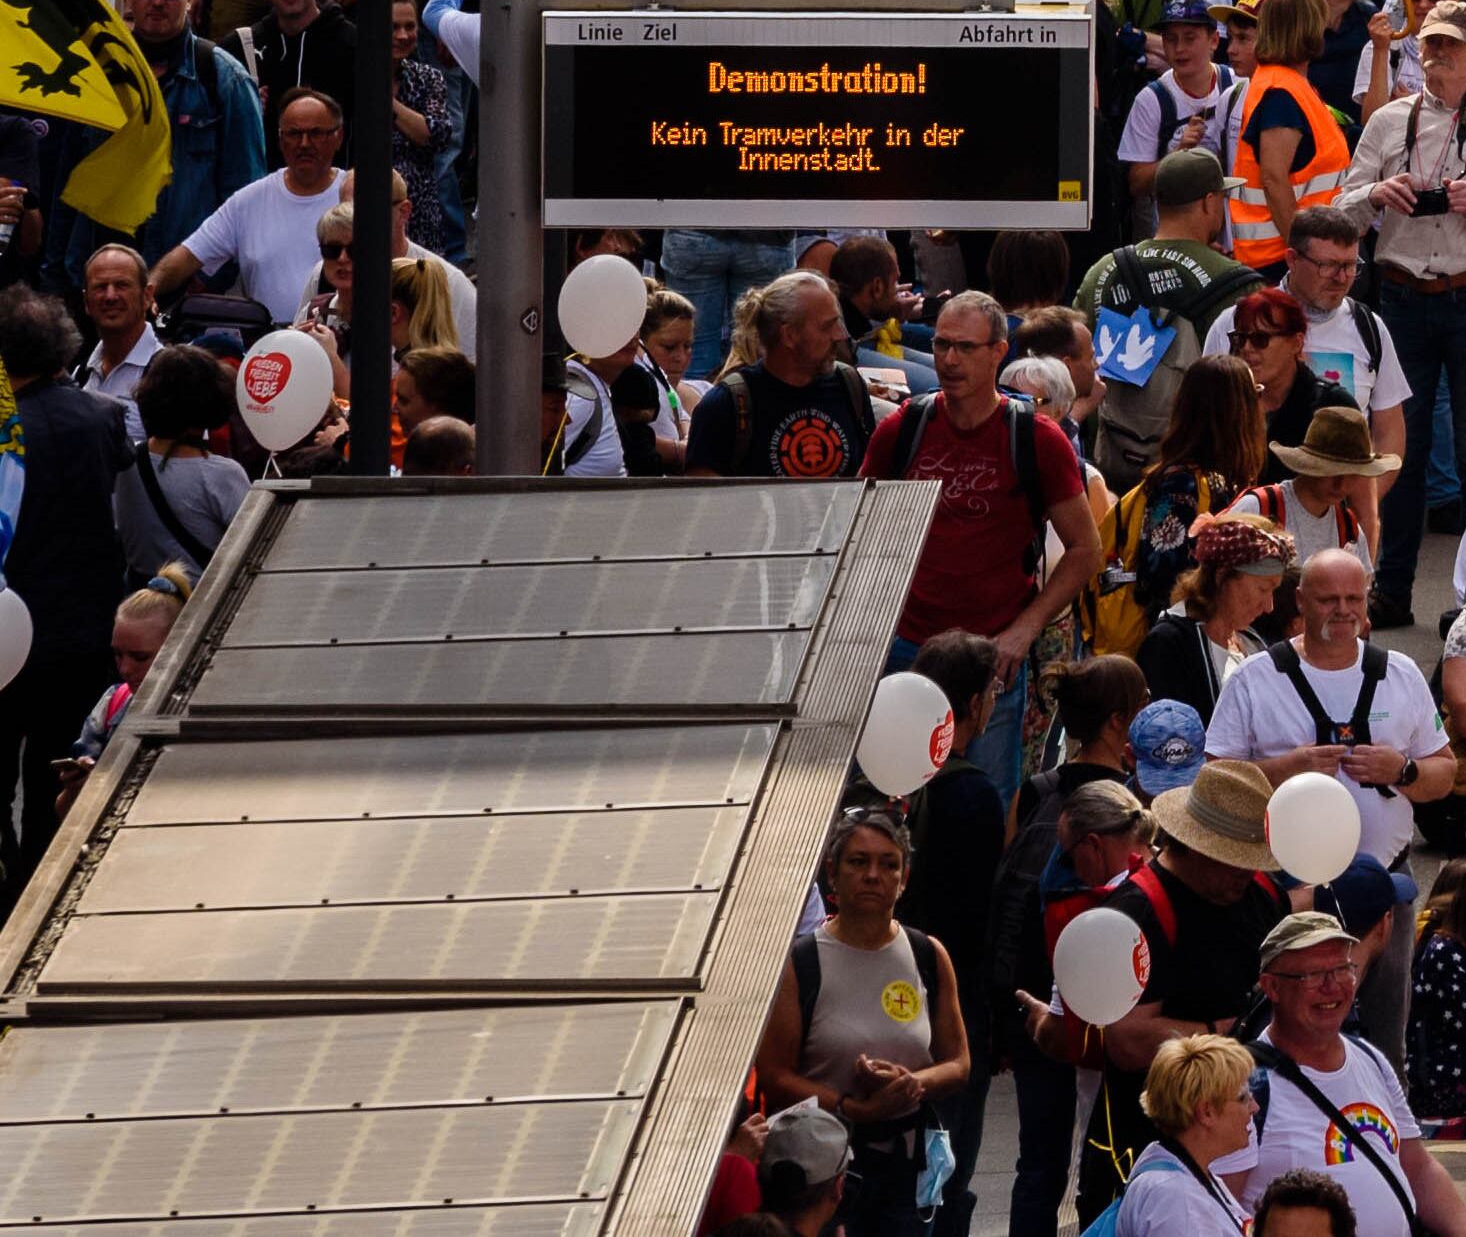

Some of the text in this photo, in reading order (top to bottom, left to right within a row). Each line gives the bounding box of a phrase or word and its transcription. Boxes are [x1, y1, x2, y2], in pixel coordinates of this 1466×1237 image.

[577, 23, 1057, 44] Linie Ziel Abfahrt in
[708, 61, 927, 95] Demonstration!
[650, 120, 965, 146] Kein Tramverkehr in der
[738, 146, 881, 171] Innenstadt.
[1061, 190, 1079, 200] BVG
[1330, 1108, 1396, 1153] BRLIN
